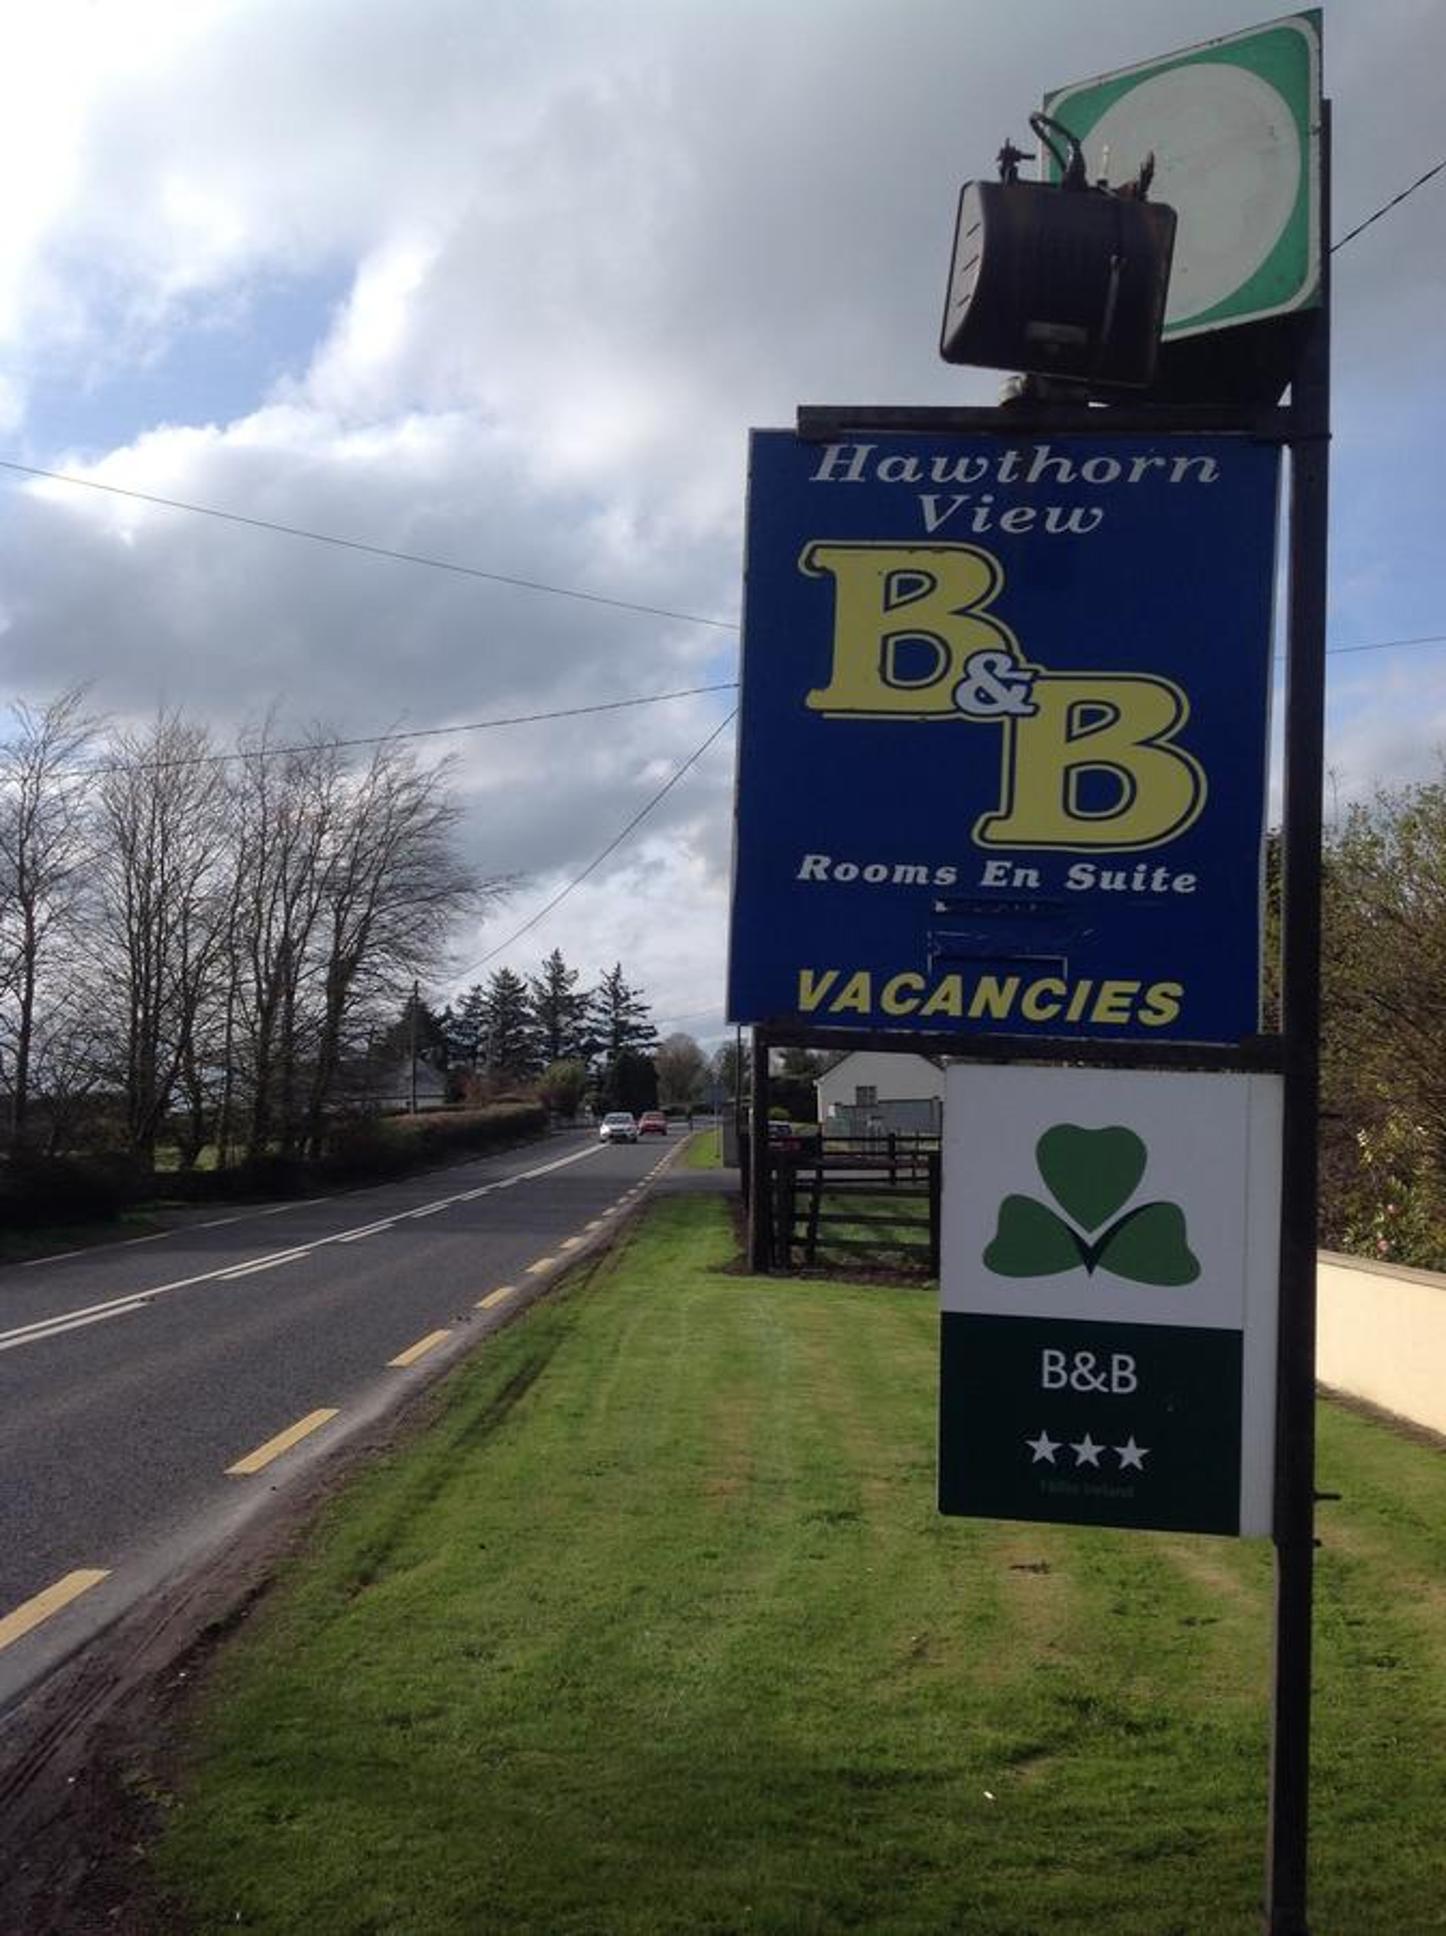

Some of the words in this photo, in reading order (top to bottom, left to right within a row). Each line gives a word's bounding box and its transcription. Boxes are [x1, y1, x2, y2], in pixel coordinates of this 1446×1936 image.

[808, 443, 1220, 485] Hawthorn
[917, 493, 1105, 535] View
[797, 854, 958, 886] Rooms
[980, 860, 1041, 889] En
[1065, 863, 1198, 894] Suite
[797, 969, 1185, 1026] VACANCIES
[1041, 1348, 1138, 1394] B&B
